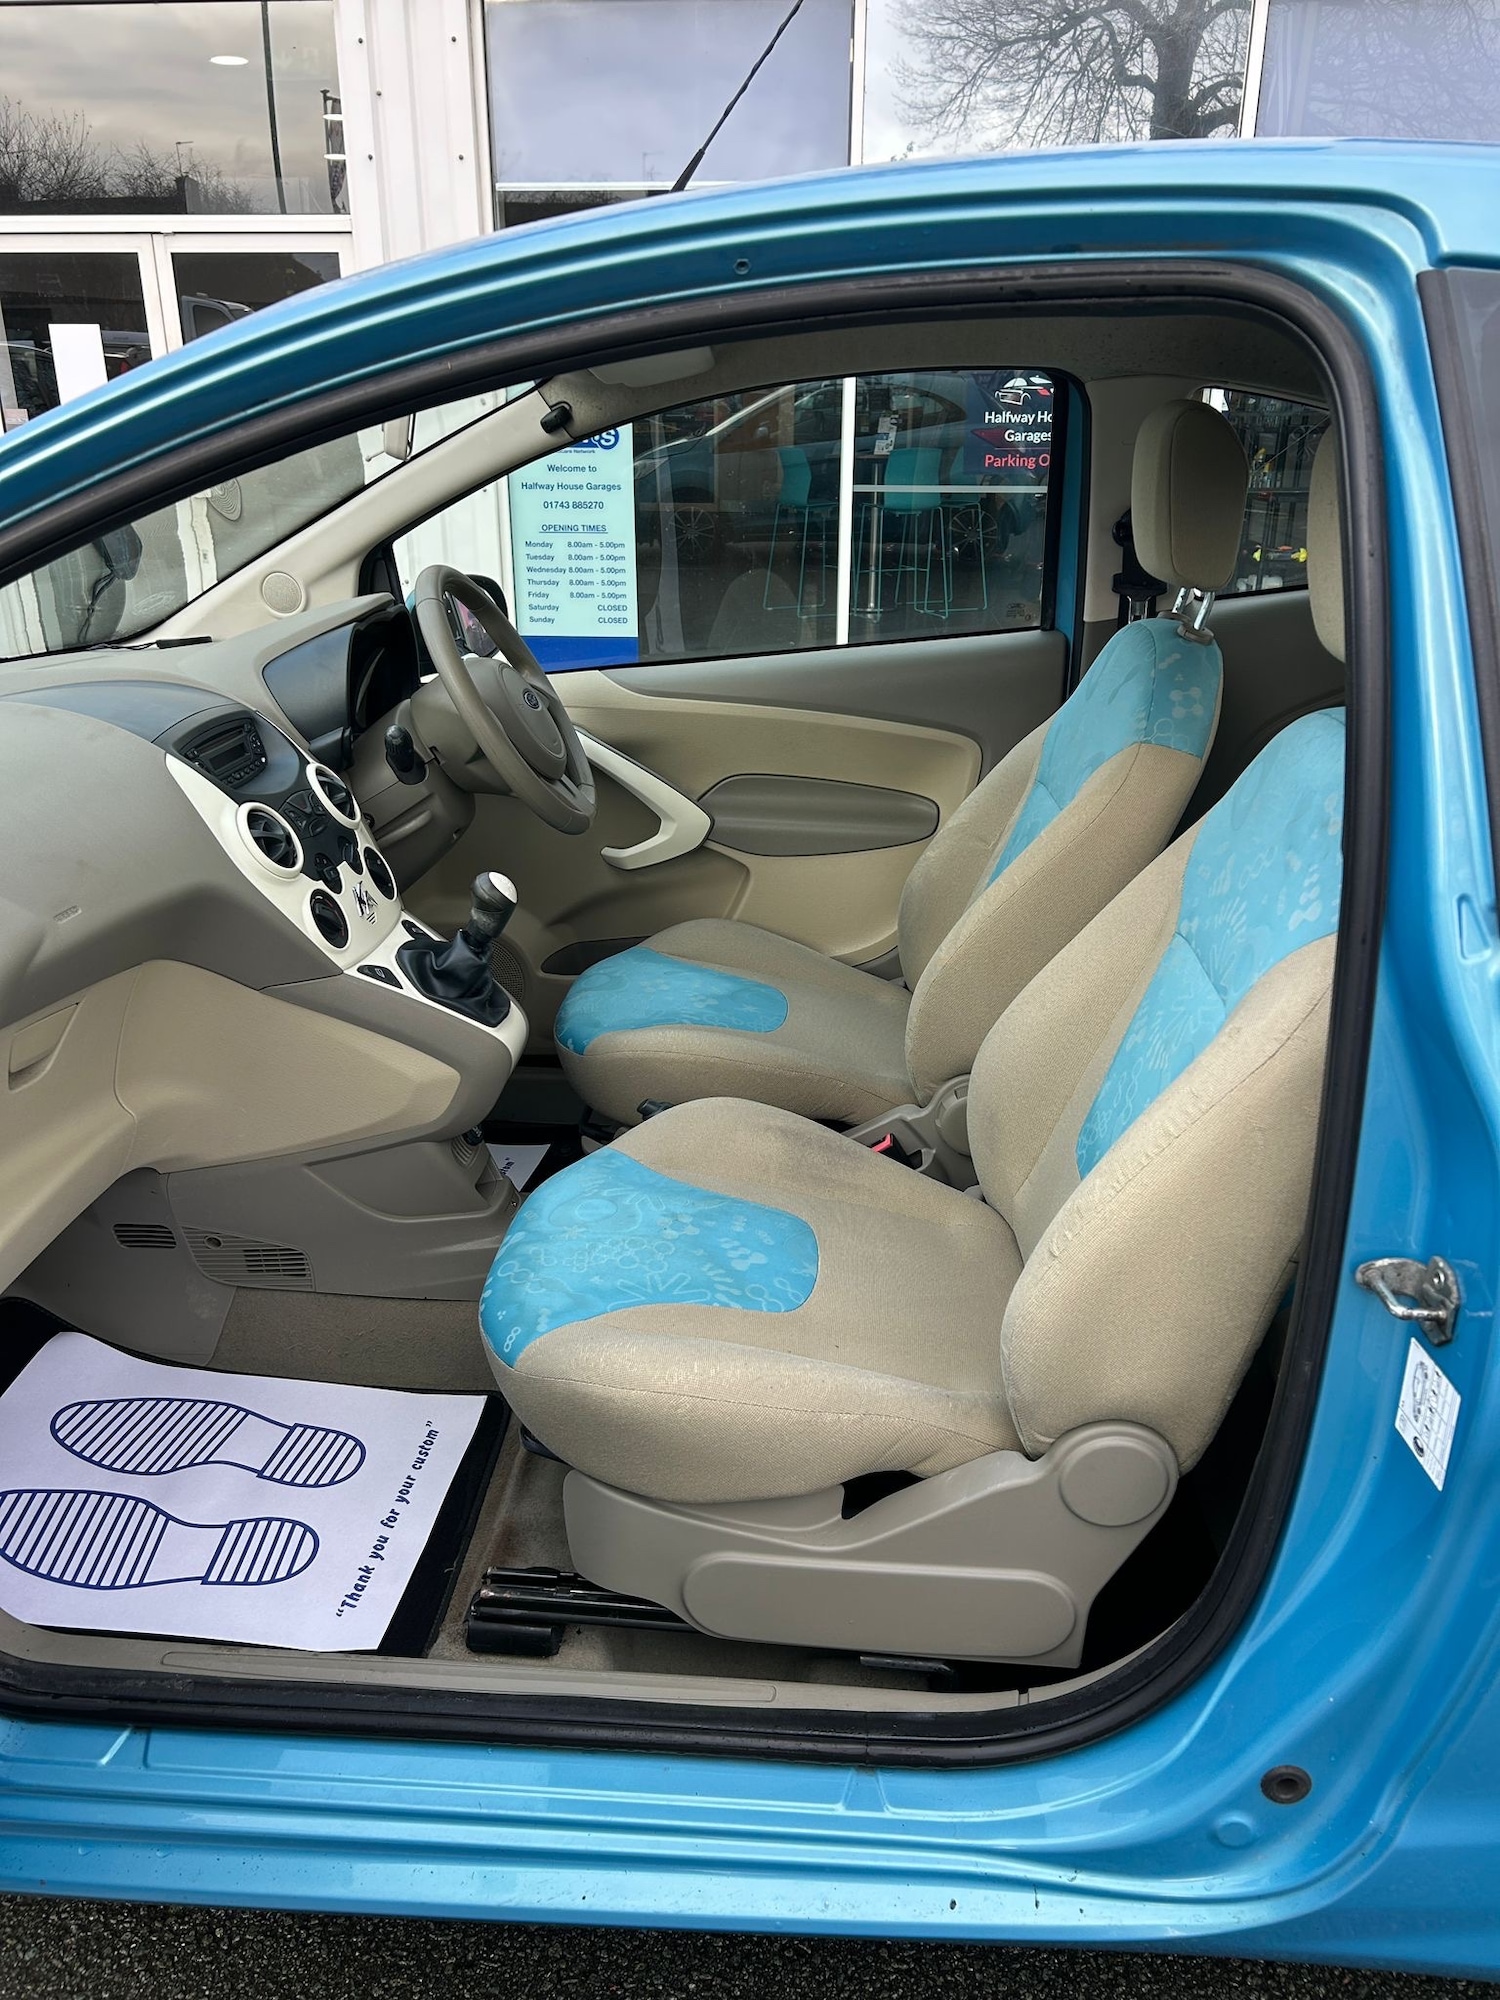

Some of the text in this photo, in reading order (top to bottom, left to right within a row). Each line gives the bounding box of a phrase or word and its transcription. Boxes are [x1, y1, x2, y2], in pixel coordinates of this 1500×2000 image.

[984, 411, 1035, 425] Halfway
[1005, 430, 1051, 443] Garages
[985, 454, 1036, 469] Parking
[547, 464, 586, 472] Welcome
[521, 482, 621, 491] Halfway House Garages
[543, 501, 604, 509] 01743 885270
[525, 553, 555, 561] Tuesday
[526, 566, 566, 574] Wednesday
[527, 579, 560, 587] Thursday
[601, 592, 627, 600] 5.00pm
[369, 1535, 390, 1562] you
[380, 1508, 400, 1529] for
[395, 1474, 417, 1504] your
